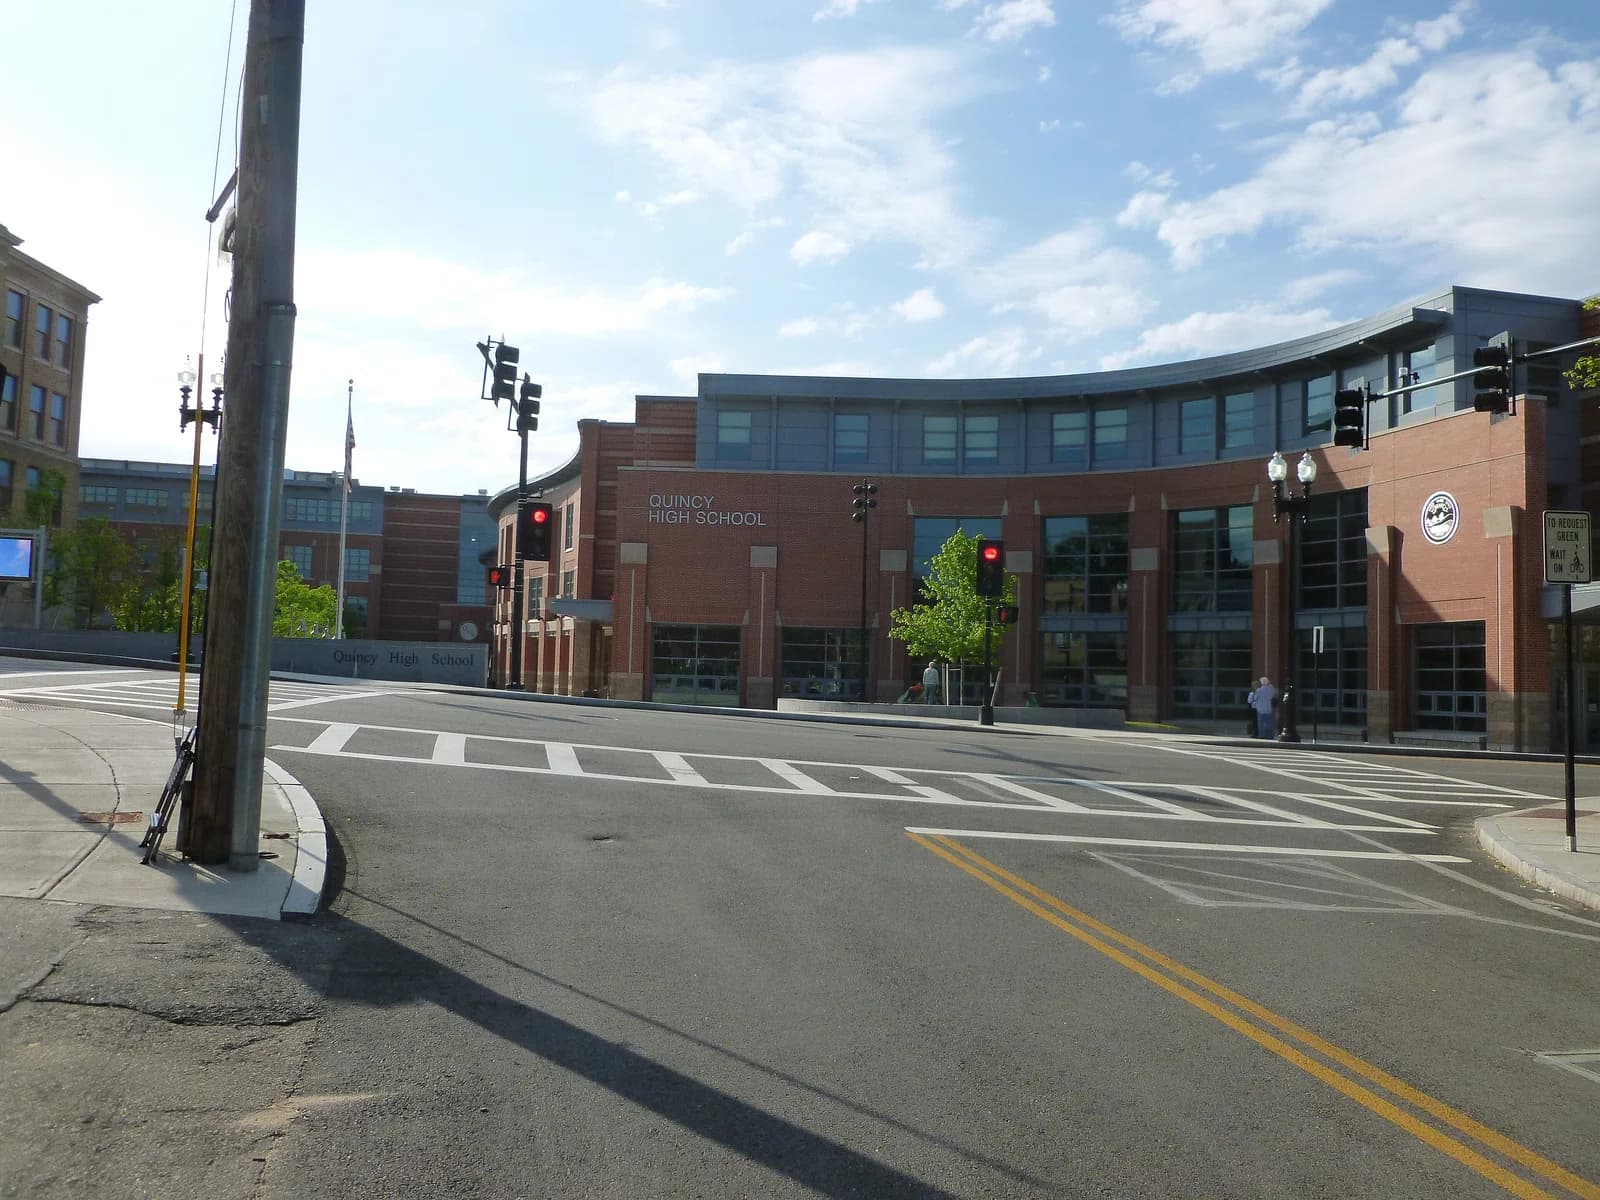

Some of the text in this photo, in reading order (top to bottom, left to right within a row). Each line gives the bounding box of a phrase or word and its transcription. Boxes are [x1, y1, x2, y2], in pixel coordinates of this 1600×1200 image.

[649, 494, 714, 509] QUINCY
[648, 510, 767, 526] HIGH SCHOOL
[1547, 517, 1587, 529] TO REQUEST
[1557, 531, 1579, 541] GREEN
[1549, 549, 1567, 560] WAIT
[1553, 563, 1563, 573] ON
[333, 649, 474, 667] Quincy High School
